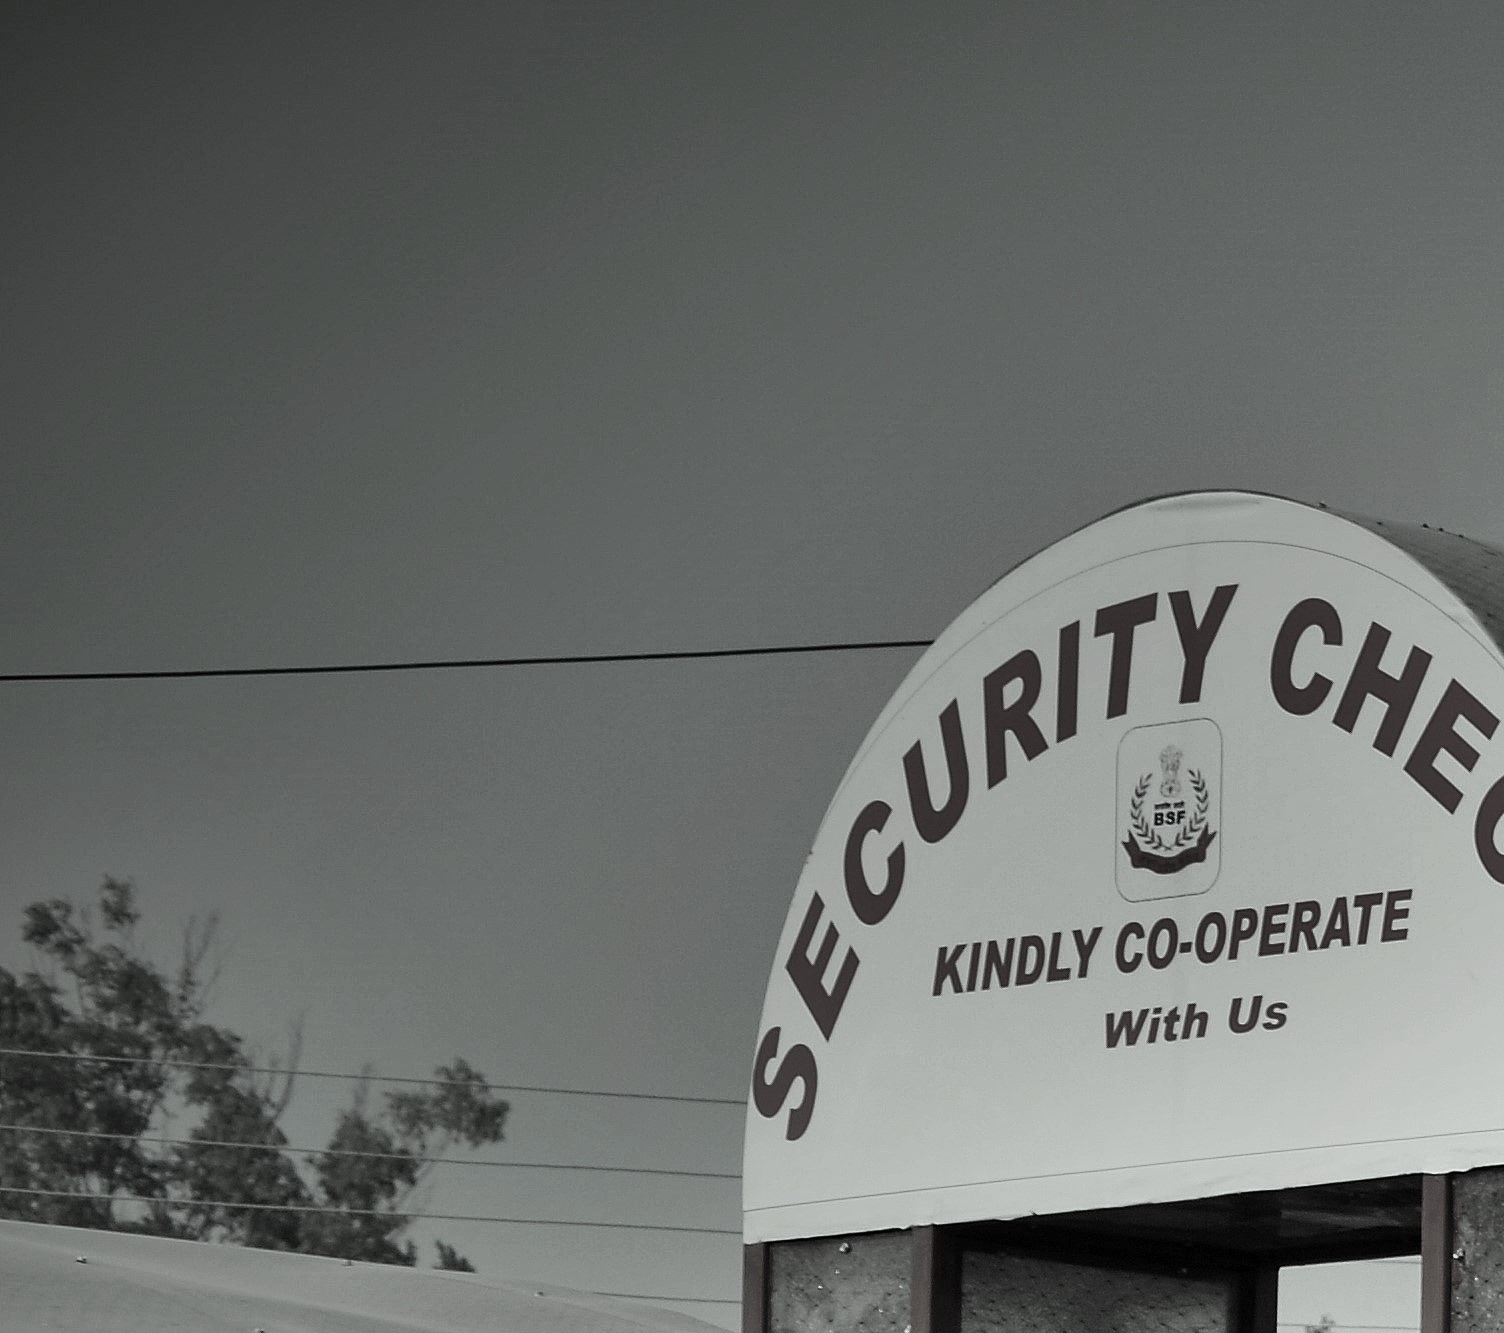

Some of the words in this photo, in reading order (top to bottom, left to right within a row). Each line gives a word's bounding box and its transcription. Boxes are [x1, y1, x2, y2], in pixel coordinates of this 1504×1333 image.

[1153, 810, 1186, 826] BSF
[753, 584, 1239, 1140] SECURITY
[933, 926, 1103, 997] KINDLY
[1115, 888, 1412, 974] CO-OPERATE
[1105, 1002, 1209, 1049] With
[1228, 995, 1288, 1034] Us
